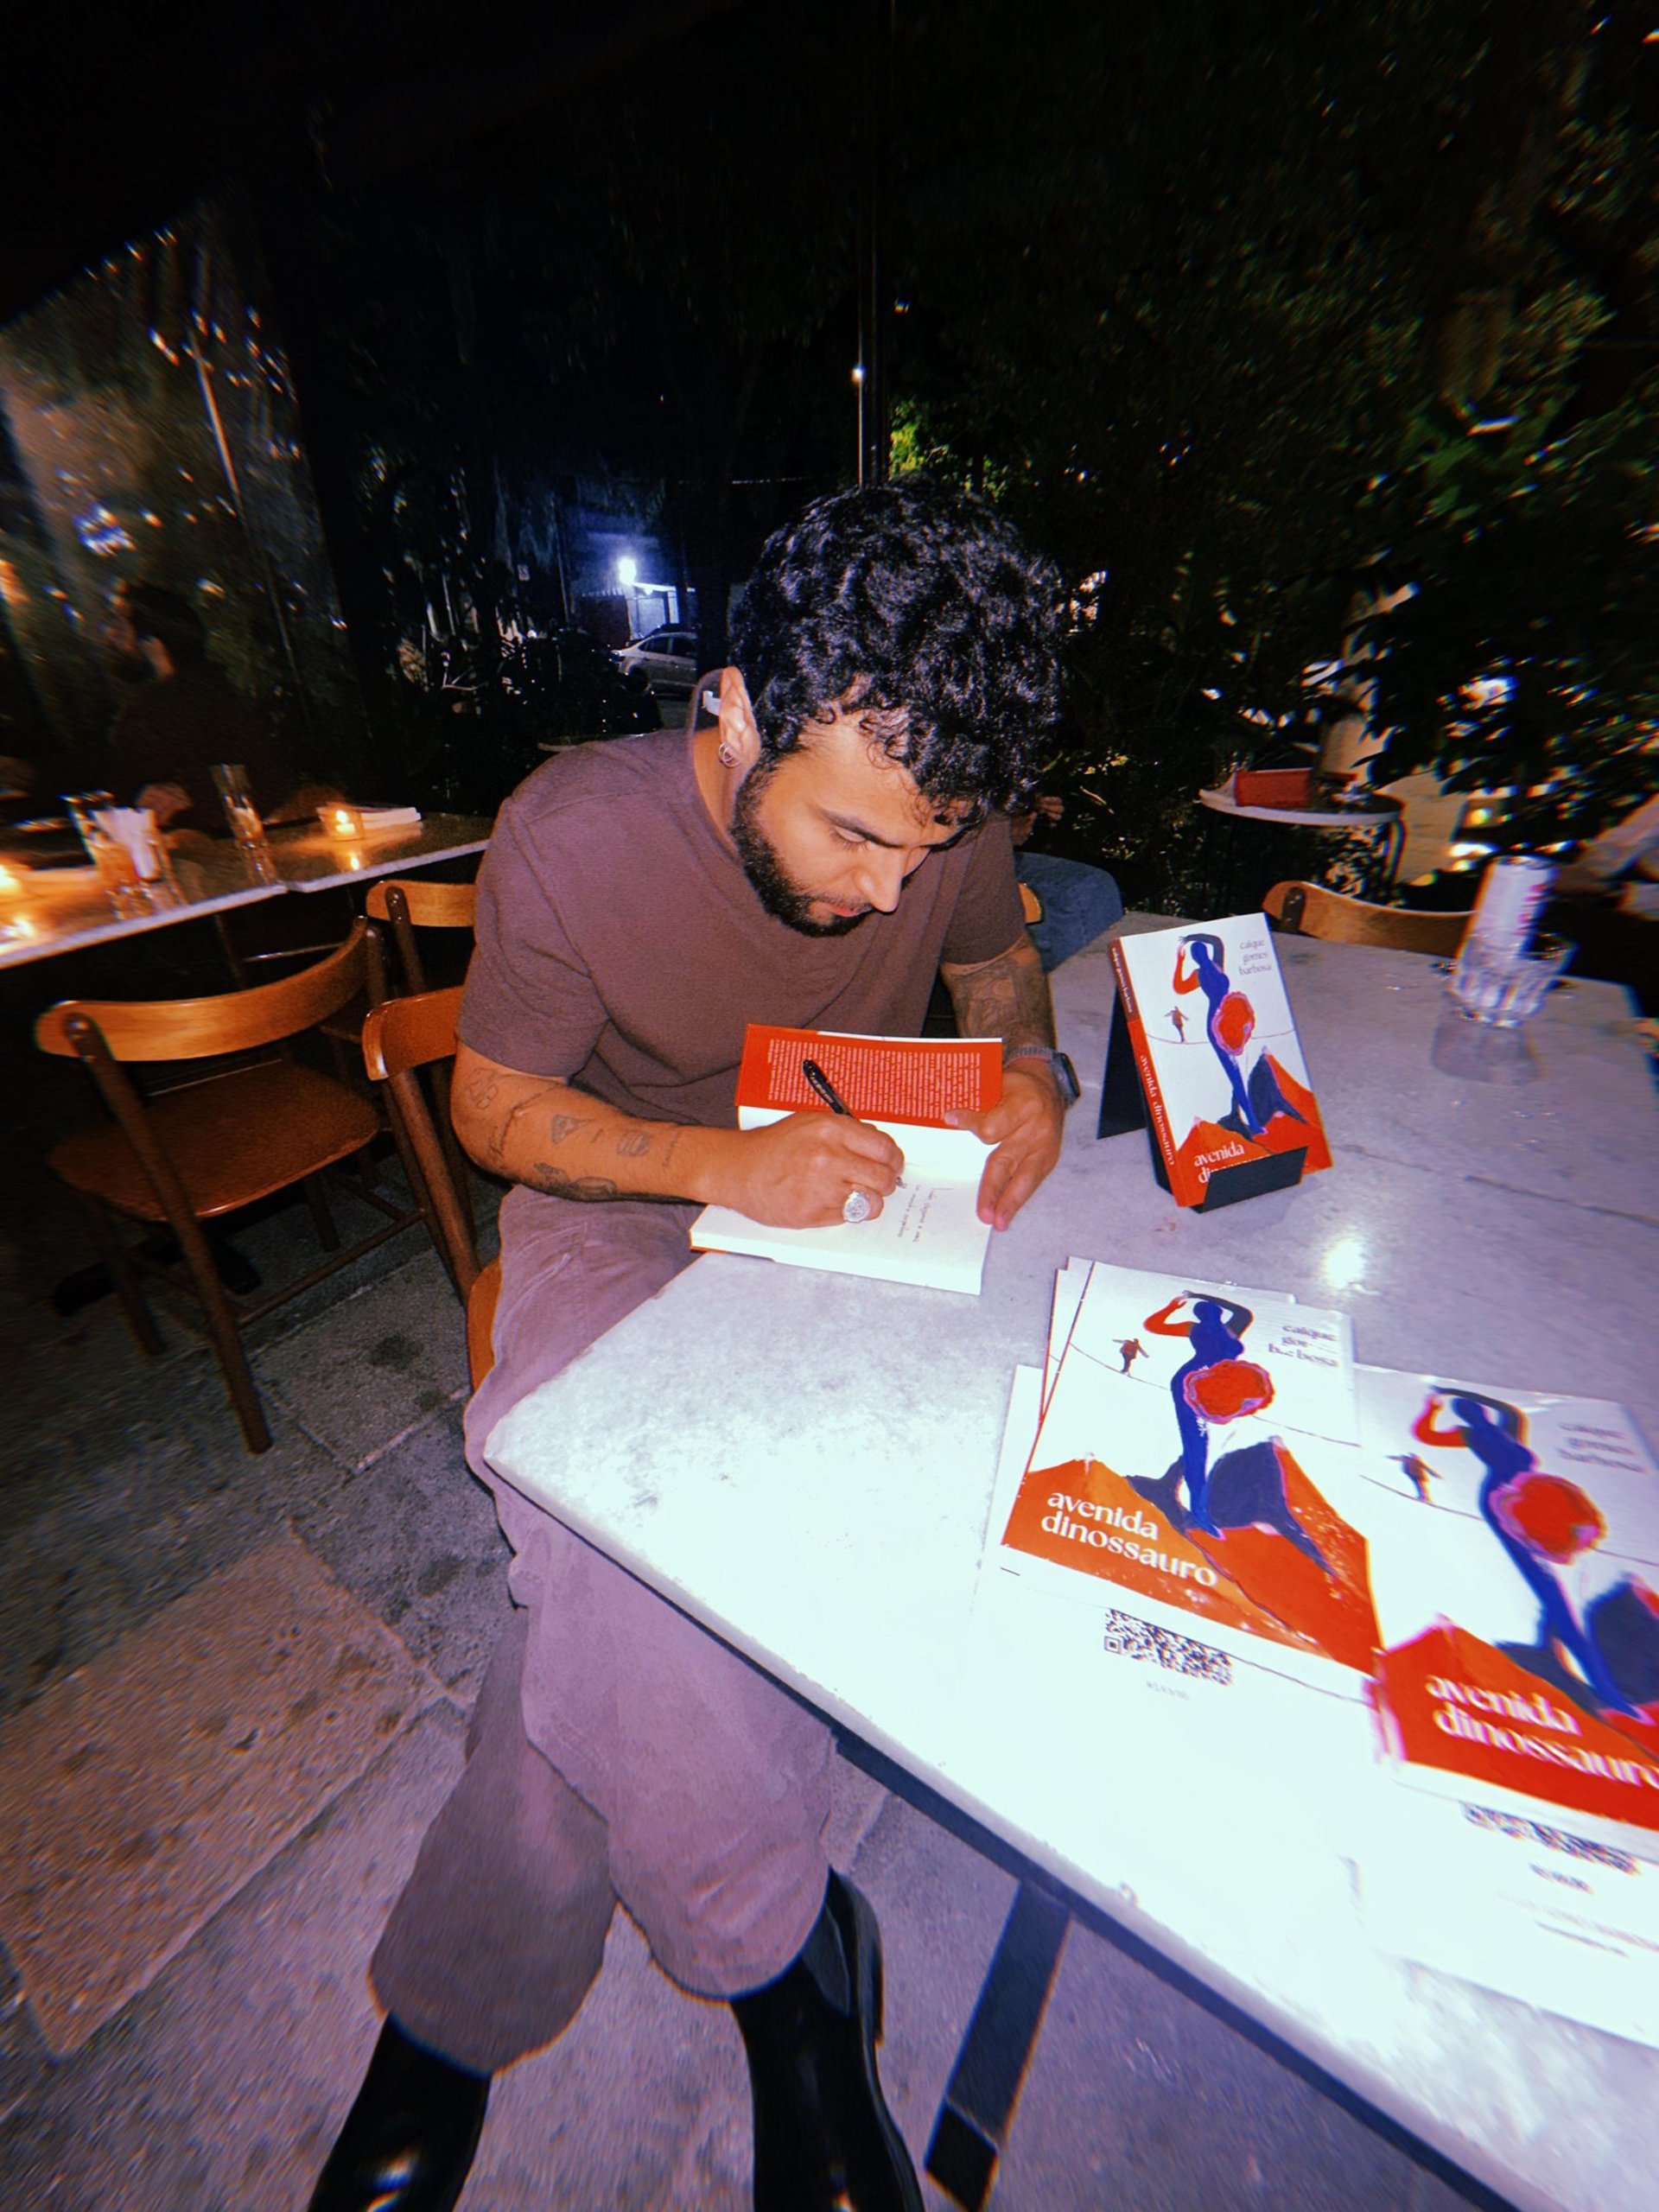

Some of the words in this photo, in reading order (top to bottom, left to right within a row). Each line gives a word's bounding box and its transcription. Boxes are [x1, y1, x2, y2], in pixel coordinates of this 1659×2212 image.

[1141, 1055, 1158, 1097] avenida
[1194, 1141, 1245, 1166] avenida
[1047, 1492, 1159, 1541] avenida
[1041, 1510, 1218, 1587] dinossauro
[1425, 1674, 1583, 1737] avenida
